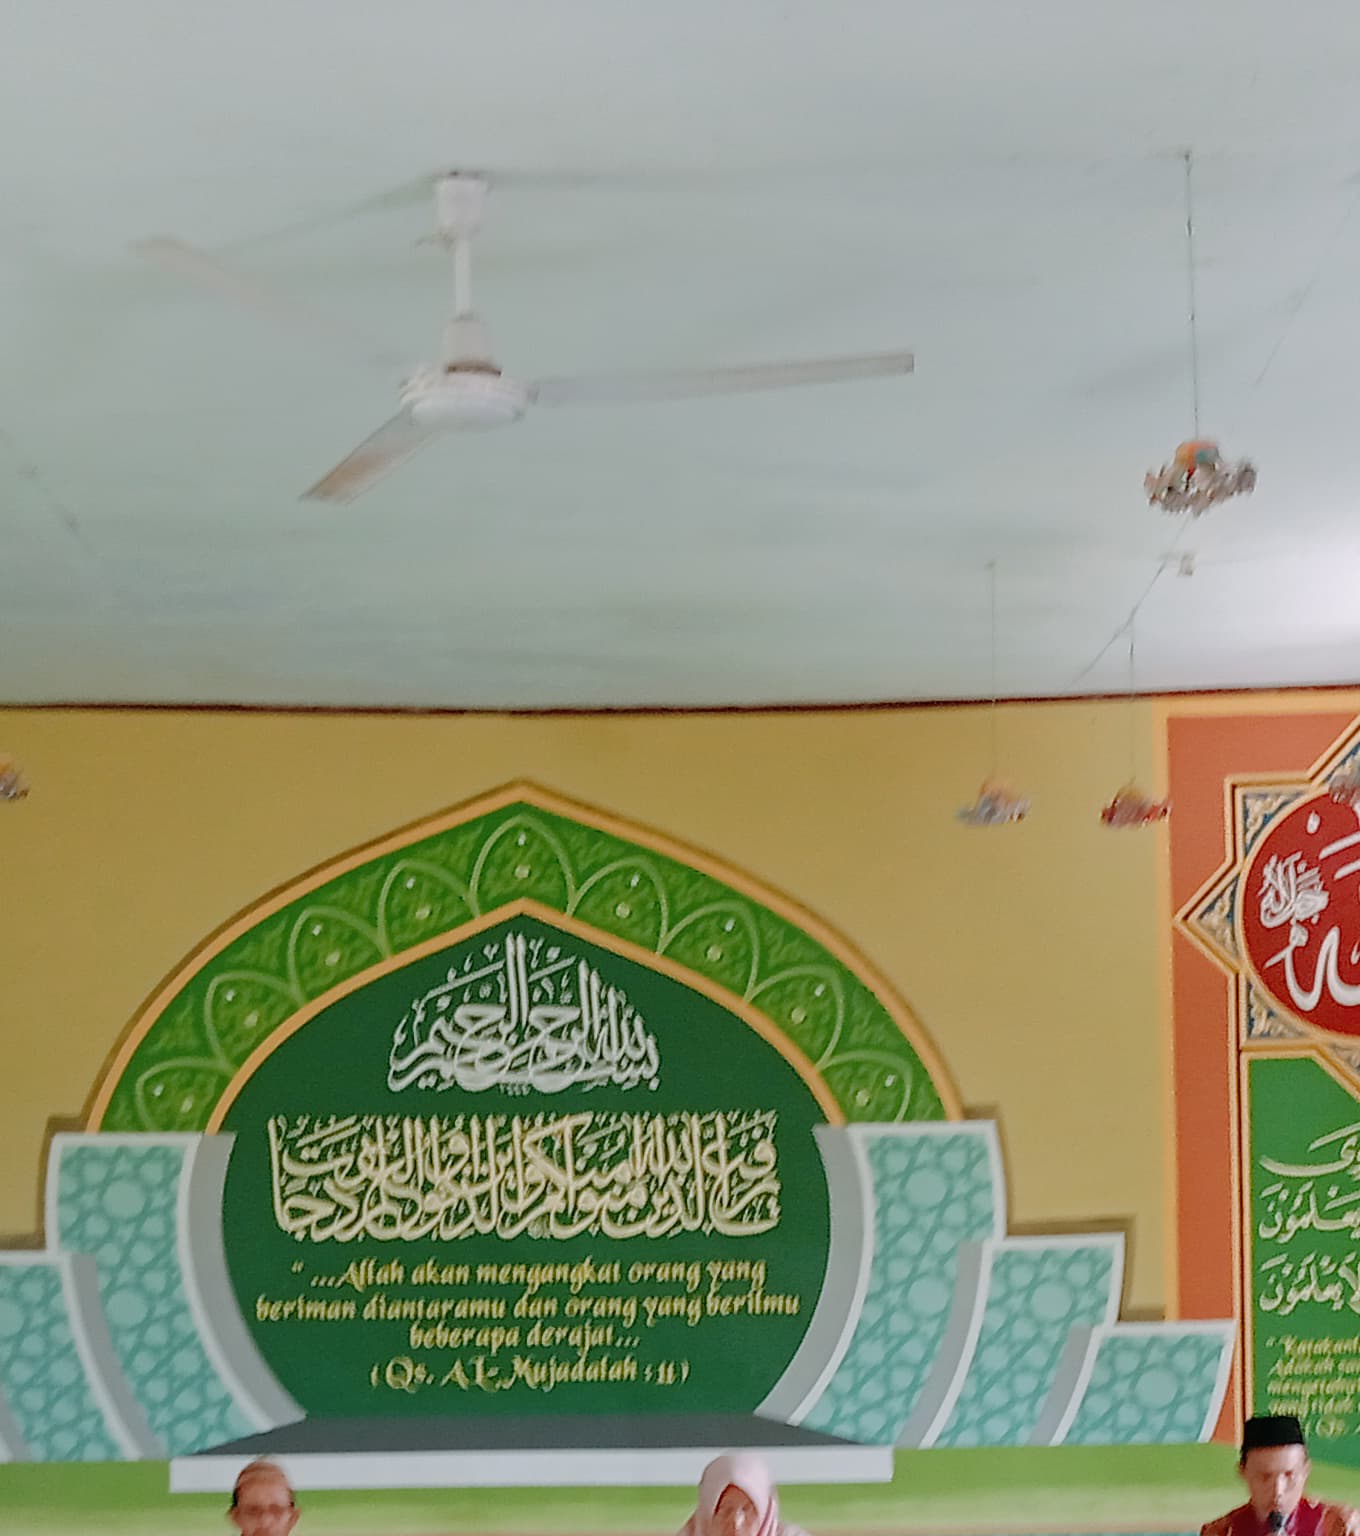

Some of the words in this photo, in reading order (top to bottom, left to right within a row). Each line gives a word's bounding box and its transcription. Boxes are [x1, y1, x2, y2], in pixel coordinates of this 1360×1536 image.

[411, 1256, 470, 1286] akan
[476, 1254, 622, 1295] mengangkat
[628, 1259, 703, 1293] orang
[706, 1259, 767, 1295] yang
[255, 1293, 357, 1322] beriman
[362, 1291, 506, 1321] diantaramu
[513, 1291, 558, 1319] dan
[564, 1296, 638, 1329] orang
[642, 1296, 703, 1327] yang
[705, 1288, 800, 1317] berilmu
[409, 1319, 521, 1358] beberapa
